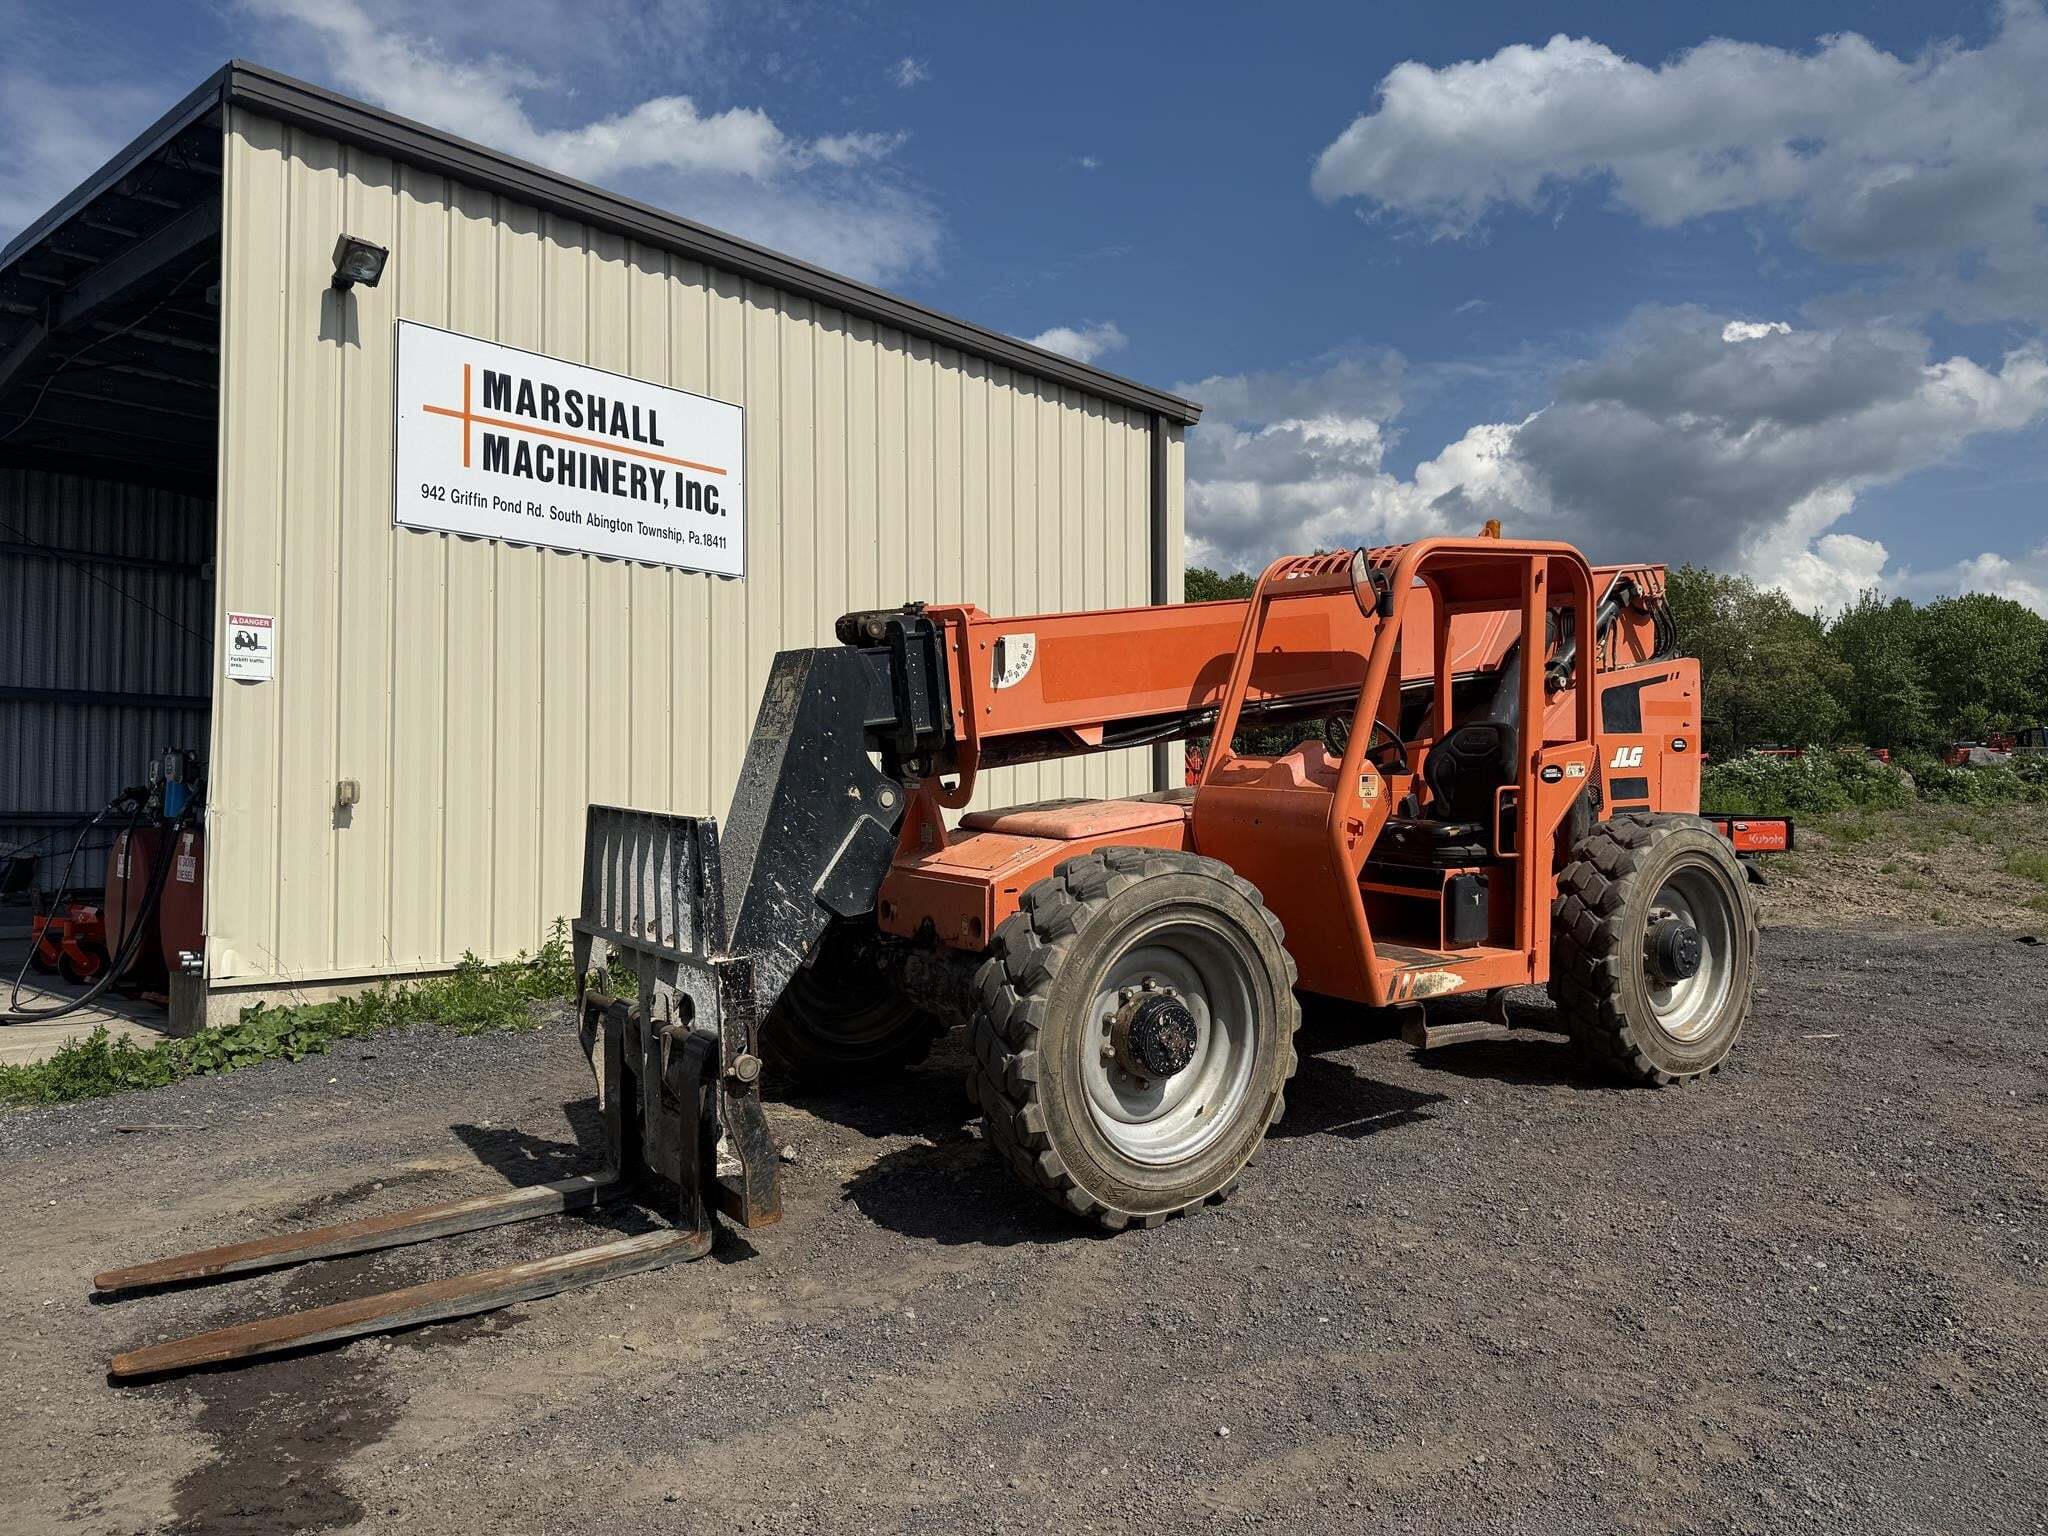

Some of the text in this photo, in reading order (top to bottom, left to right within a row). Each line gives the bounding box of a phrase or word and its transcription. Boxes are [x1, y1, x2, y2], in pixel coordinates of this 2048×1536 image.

[484, 369, 665, 447] MARSHALL
[483, 432, 727, 517] MACHINERY, Inc.
[421, 483, 446, 502] 942
[451, 489, 488, 509] Griffin
[493, 496, 522, 515] Pond
[527, 503, 545, 518] Rd.
[549, 507, 582, 526] South
[586, 512, 633, 535] Abington
[638, 521, 685, 543] Township,
[240, 618, 270, 627] DANGER
[1609, 746, 1644, 768] JLG
[1749, 834, 1784, 844] Kubota
